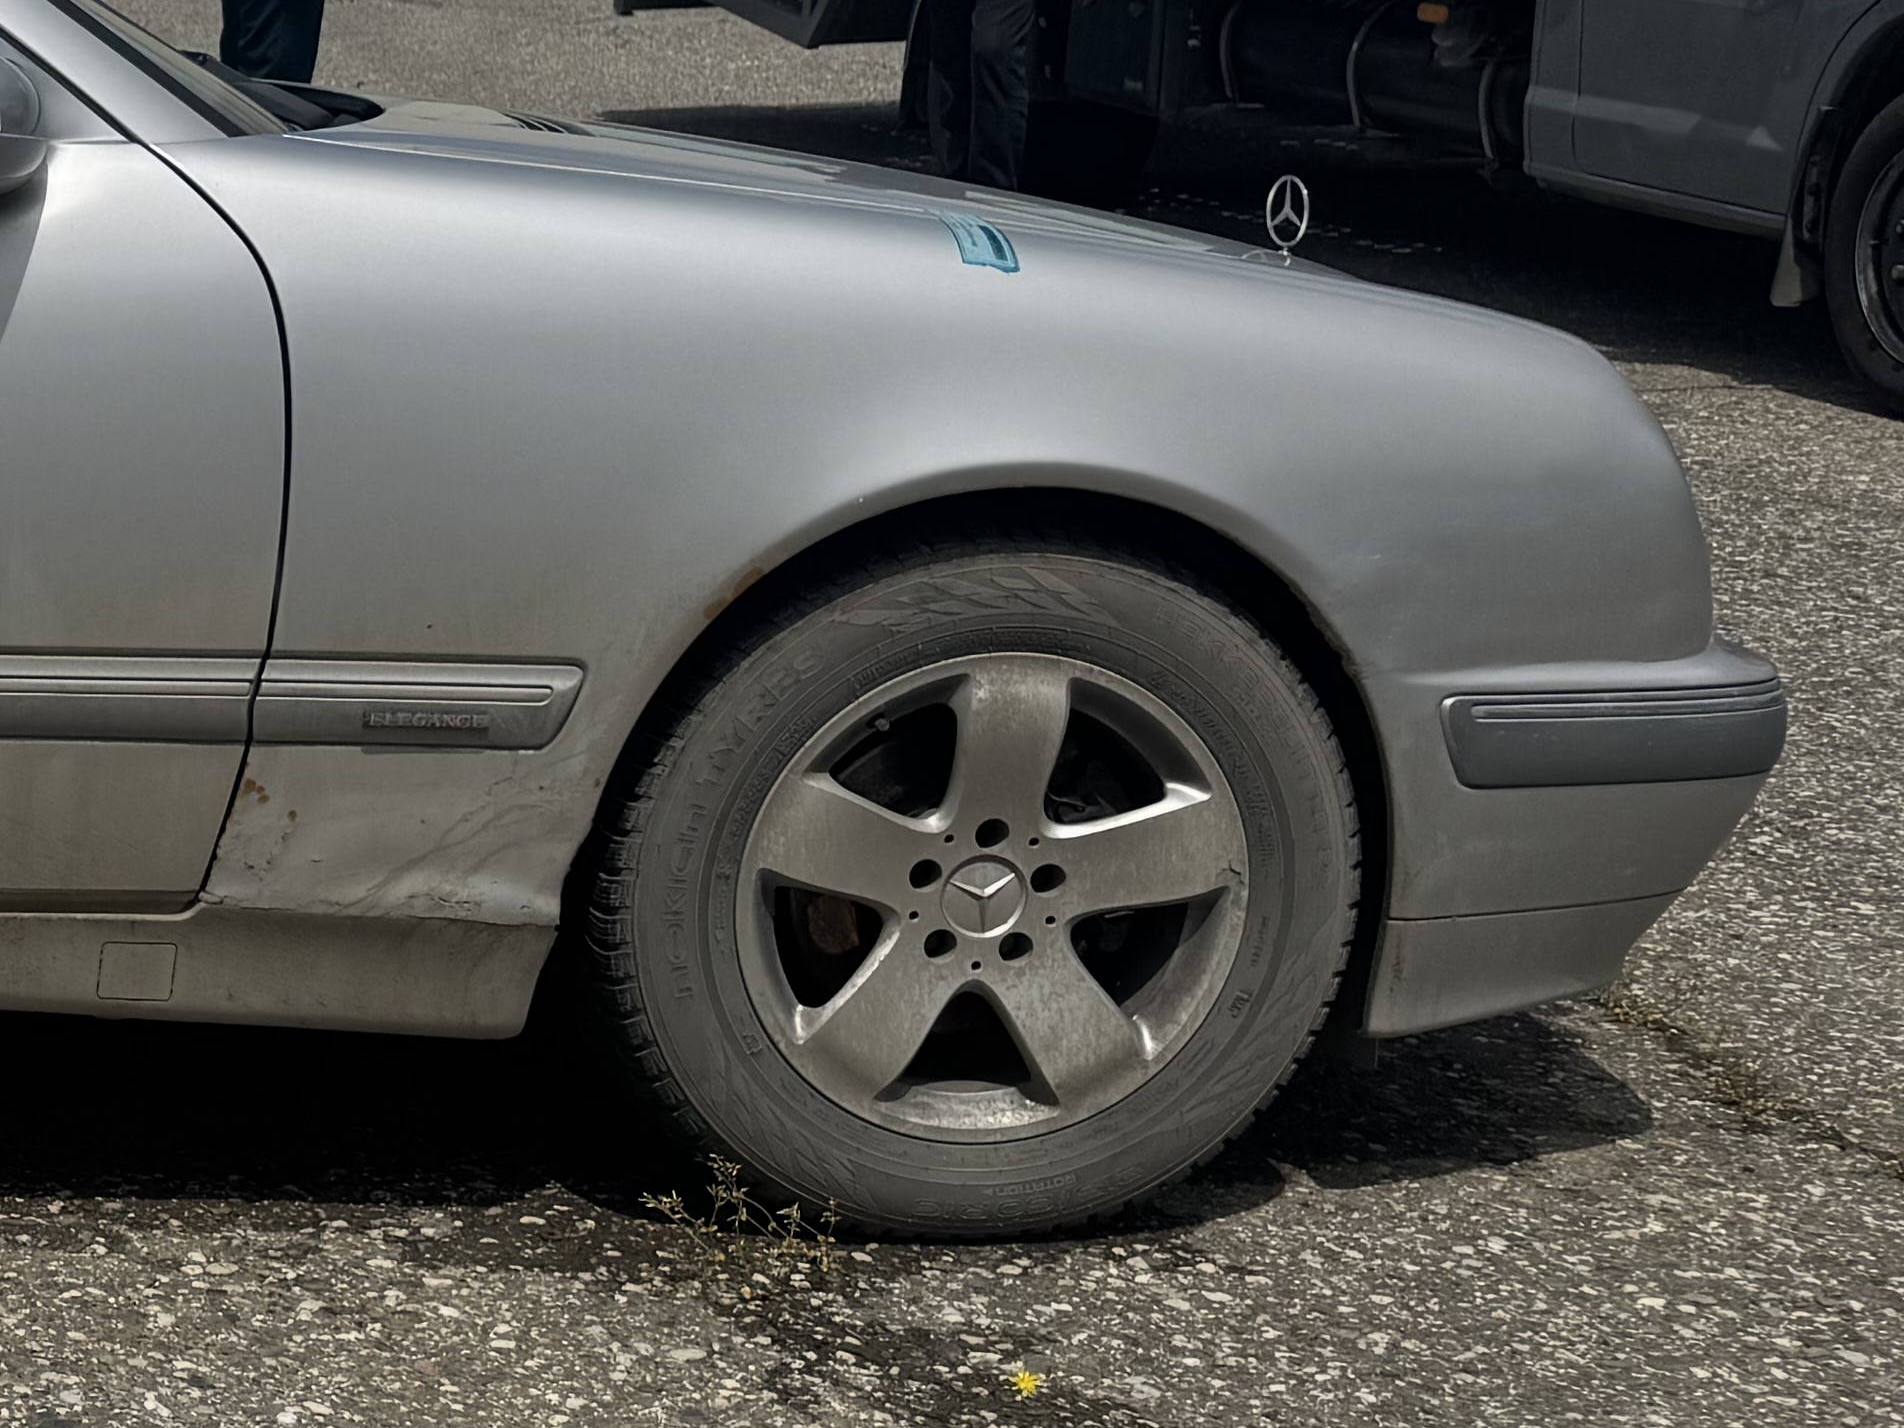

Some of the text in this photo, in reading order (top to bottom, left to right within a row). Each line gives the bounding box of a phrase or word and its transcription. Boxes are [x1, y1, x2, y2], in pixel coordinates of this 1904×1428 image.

[368, 712, 490, 729] ELEGANCE
[695, 644, 825, 786] TYRES
[996, 1173, 1076, 1197] ROTATION
